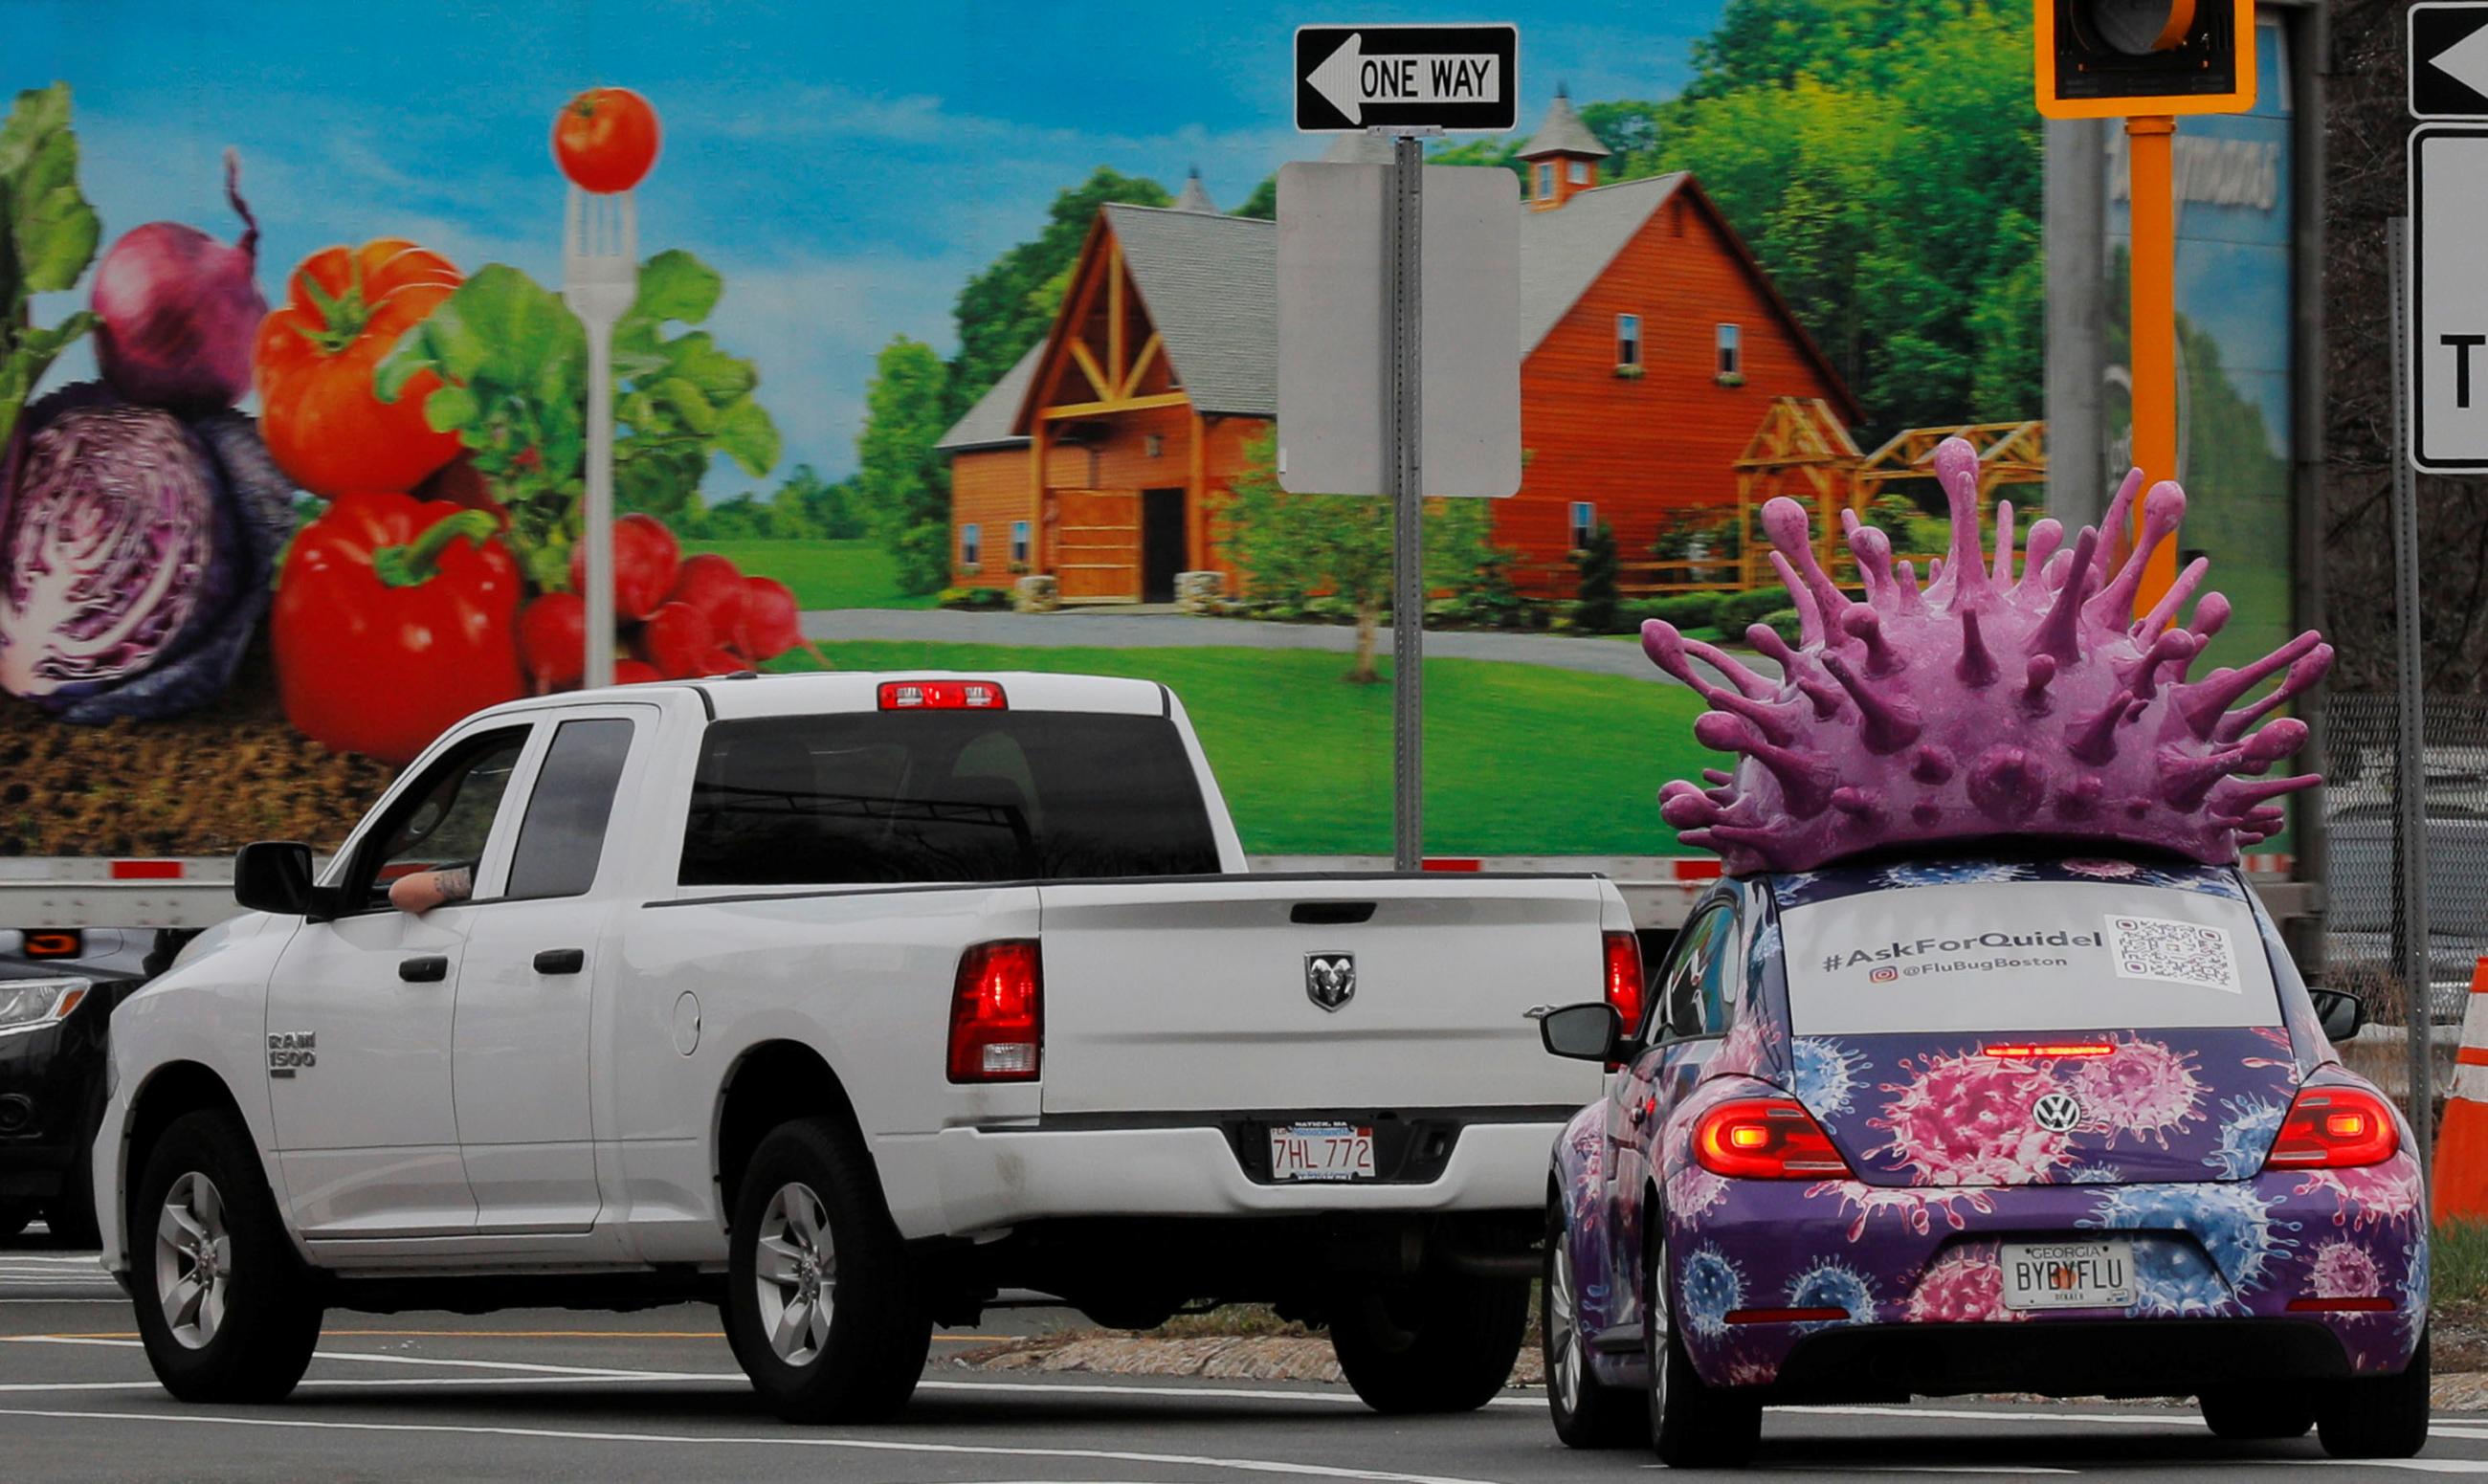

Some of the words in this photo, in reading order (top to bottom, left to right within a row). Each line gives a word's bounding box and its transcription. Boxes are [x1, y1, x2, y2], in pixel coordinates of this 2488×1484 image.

[1360, 59, 1418, 98] ONE
[1431, 59, 1491, 98] WAY
[2439, 334, 2486, 409] T
[1822, 931, 2103, 972] #AskForQuidel
[1903, 958, 2068, 977] @FluBugBoston
[268, 1032, 317, 1049] RAM
[269, 1050, 317, 1067] 1500
[1273, 1139, 1319, 1169] 7HL
[1324, 1139, 1371, 1168] 772
[2031, 1246, 2101, 1259] GEORGIA
[2016, 1259, 2123, 1292] BYBYFLU
